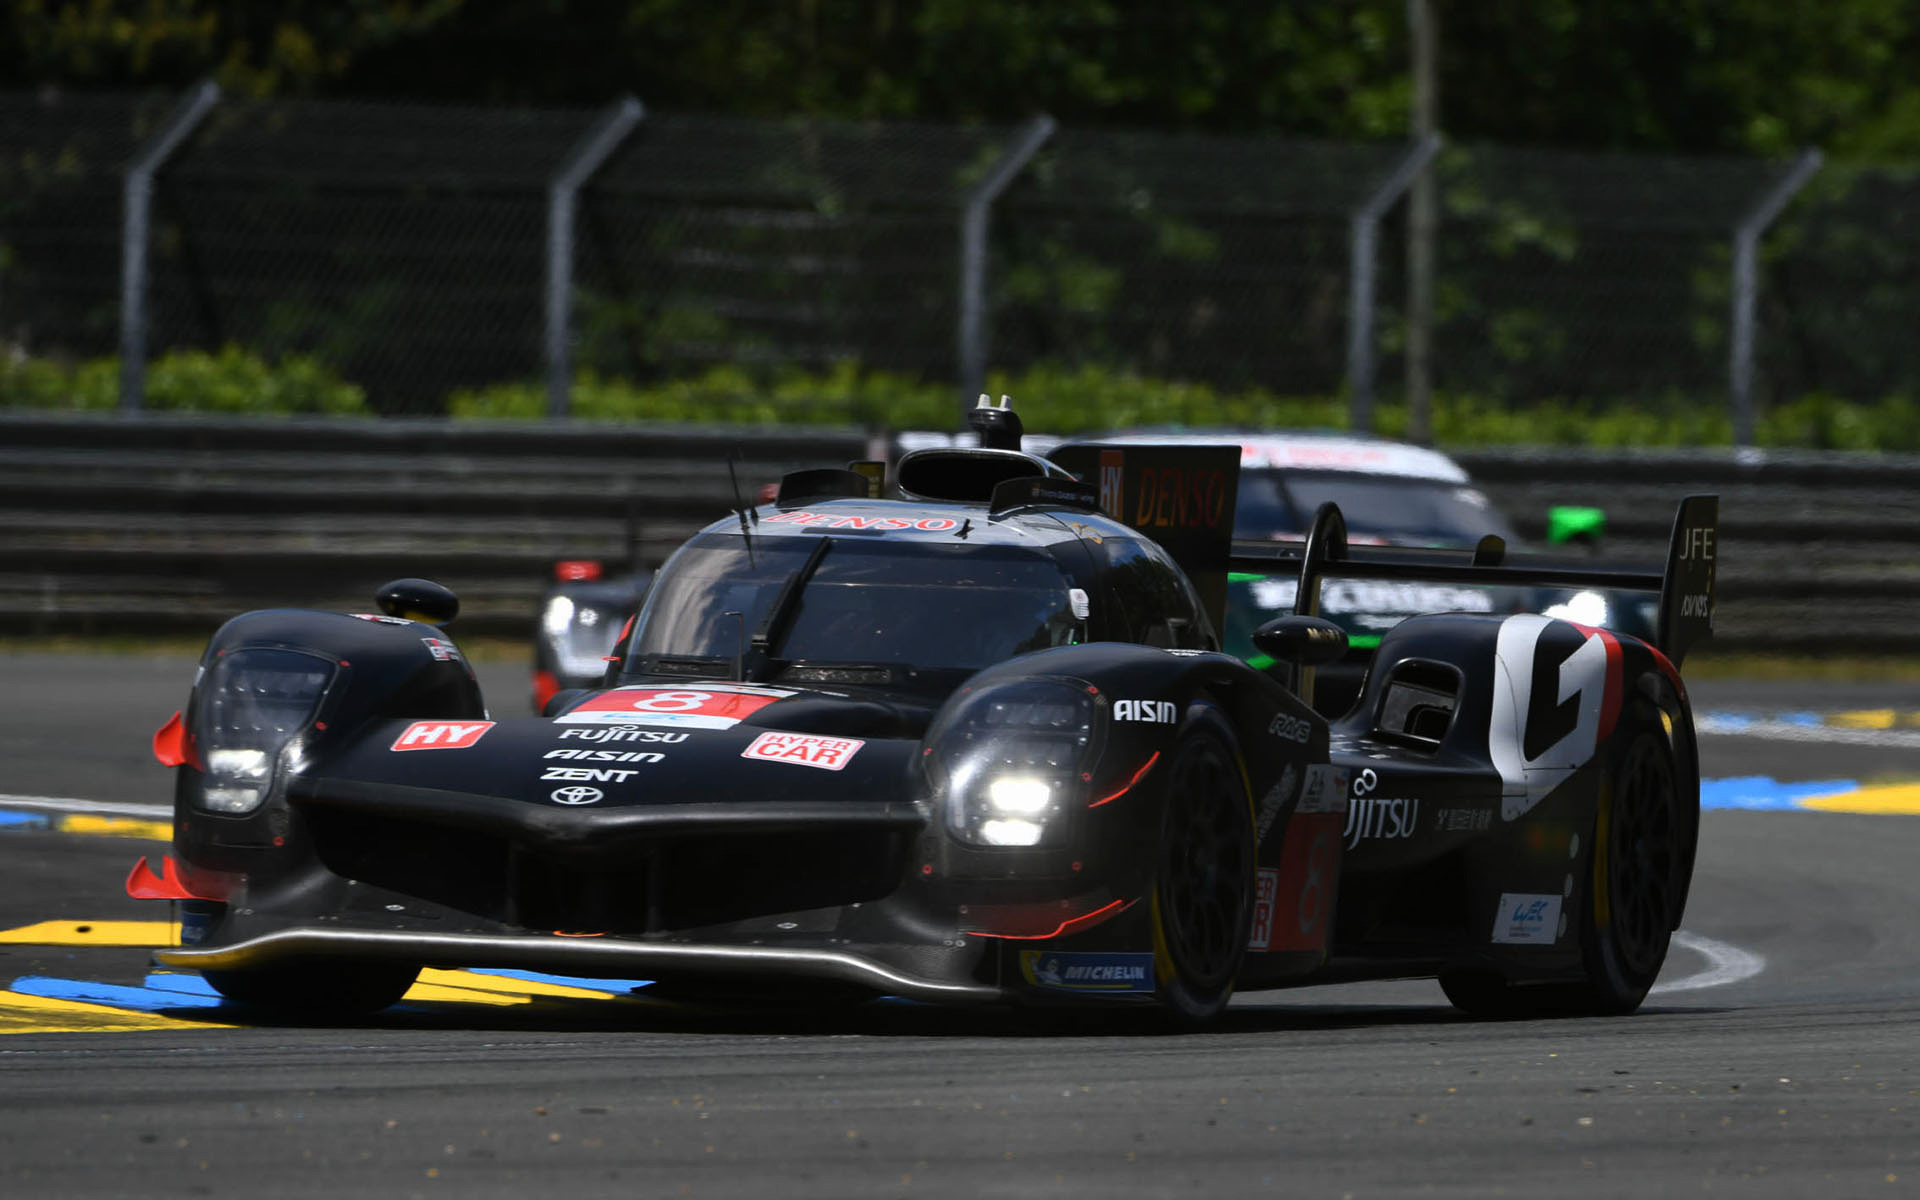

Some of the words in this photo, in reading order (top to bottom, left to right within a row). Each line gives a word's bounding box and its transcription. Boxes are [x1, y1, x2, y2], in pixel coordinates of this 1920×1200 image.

[1100, 465, 1122, 517] HY
[1136, 467, 1225, 528] DENSO
[760, 512, 957, 531] DENSO
[1679, 528, 1715, 560] JFE
[633, 691, 713, 711] 8
[1113, 699, 1177, 723] AISIN
[403, 724, 476, 746] HY
[558, 725, 690, 743] FUJITSU
[766, 732, 852, 751] HYPER
[543, 749, 666, 763] AISIN
[757, 741, 843, 766] CAR
[540, 767, 639, 783] ZENT
[1064, 965, 1145, 980] MICHELIN
